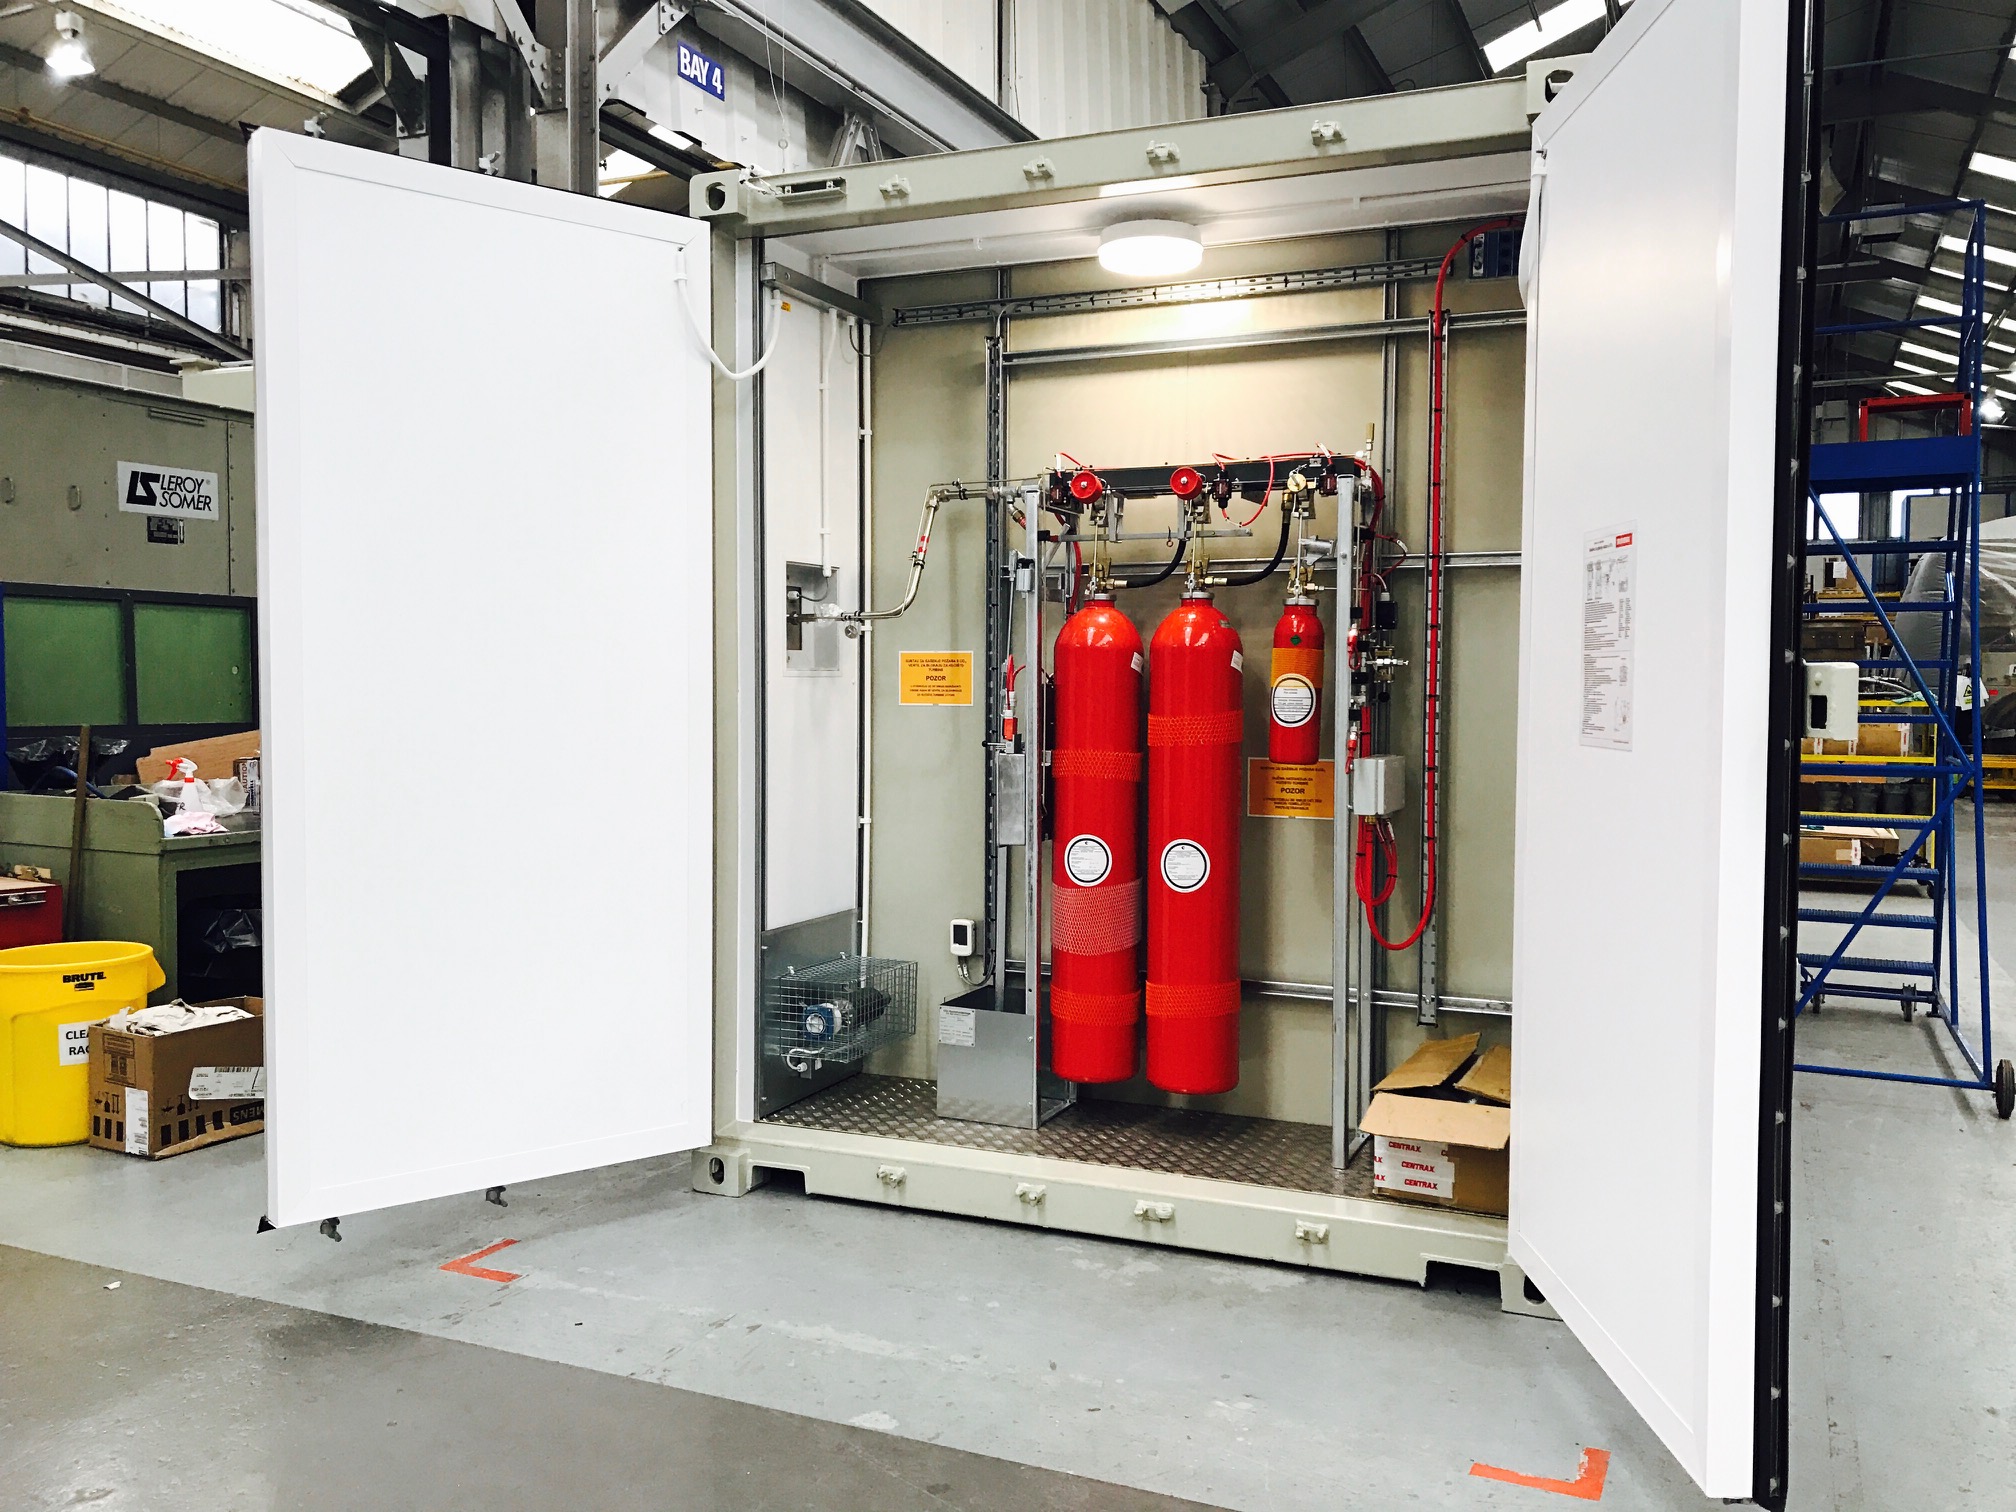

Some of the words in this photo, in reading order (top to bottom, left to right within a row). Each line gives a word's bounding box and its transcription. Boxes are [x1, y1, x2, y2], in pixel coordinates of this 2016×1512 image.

[680, 46, 709, 86] BAY
[712, 67, 722, 94] 4
[160, 474, 204, 494] LEROY
[159, 491, 212, 511] SOMER
[63, 972, 106, 983] BRUTE
[233, 1106, 264, 1121] MENS
[1388, 1141, 1421, 1153] CENTRAX
[1401, 1161, 1435, 1173] CENTRAX
[1404, 1179, 1438, 1190] CENTRAX
